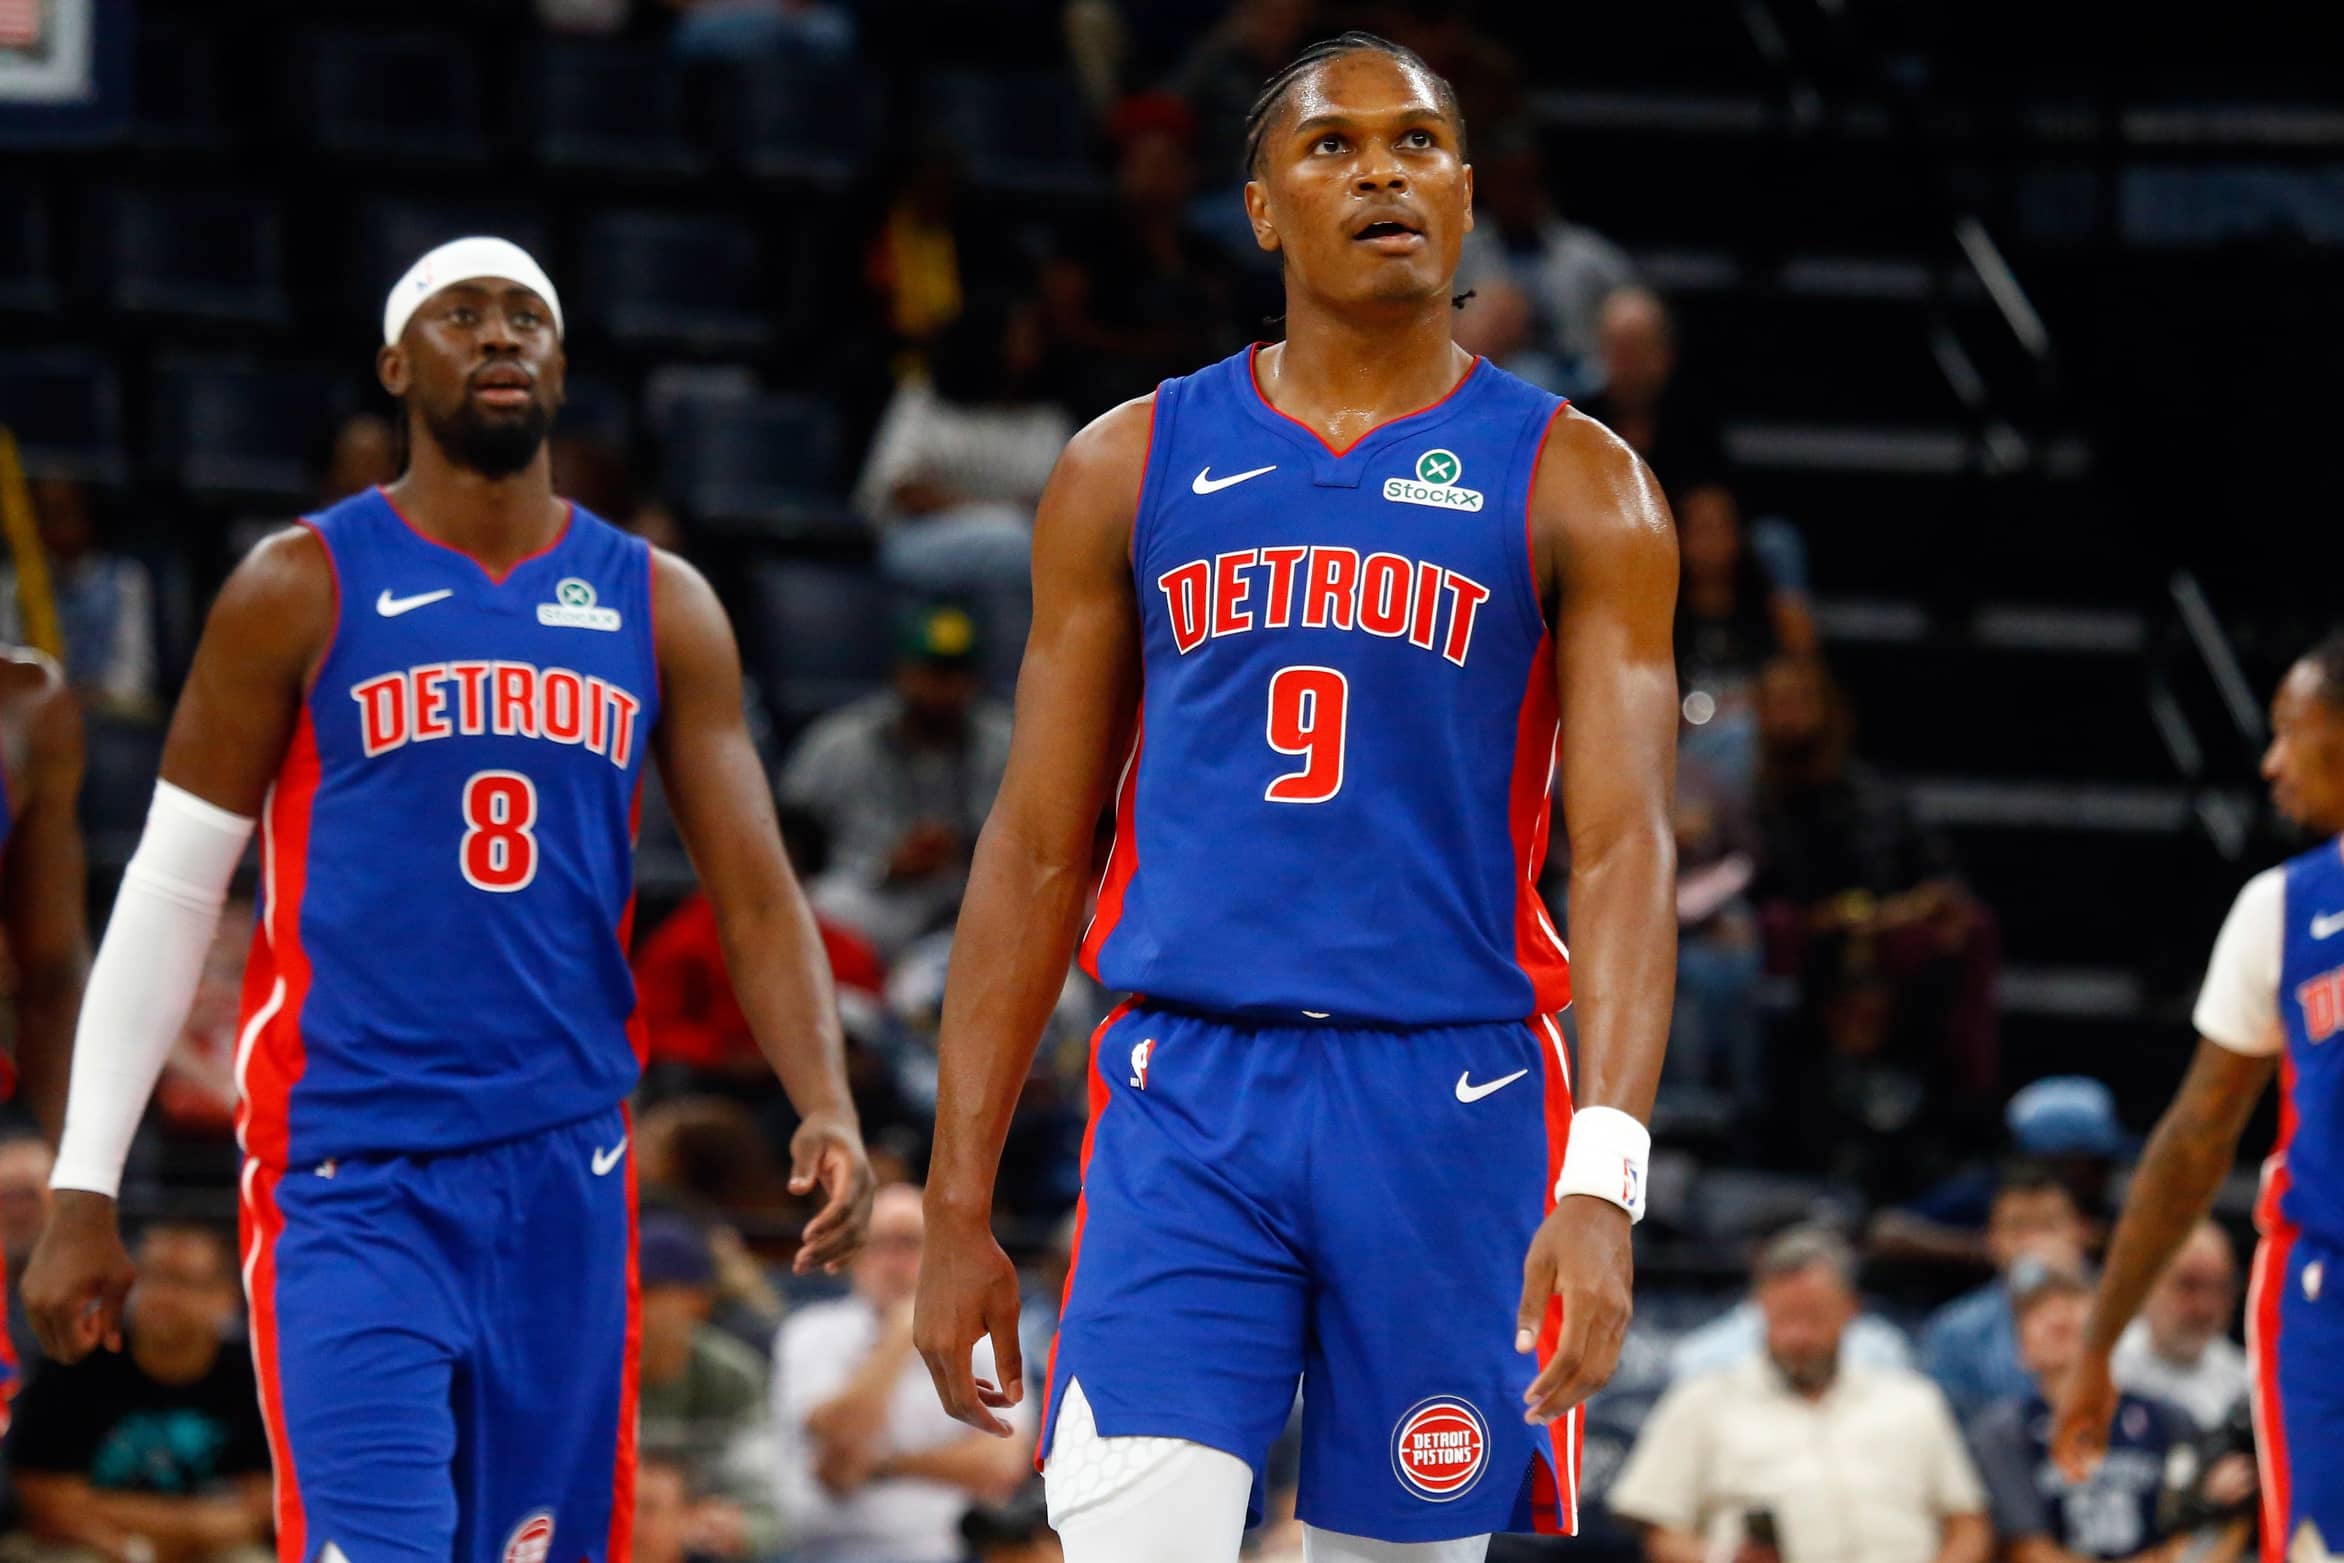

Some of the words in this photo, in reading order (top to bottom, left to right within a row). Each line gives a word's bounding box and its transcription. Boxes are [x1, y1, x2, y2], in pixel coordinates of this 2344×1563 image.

[1158, 545, 1491, 668] DETROIT
[351, 659, 641, 771] DETROIT
[1263, 665, 1349, 804] 9
[459, 769, 539, 893] 8
[1412, 1430, 1472, 1449] DETROIT
[1412, 1447, 1473, 1466] PISTONS
